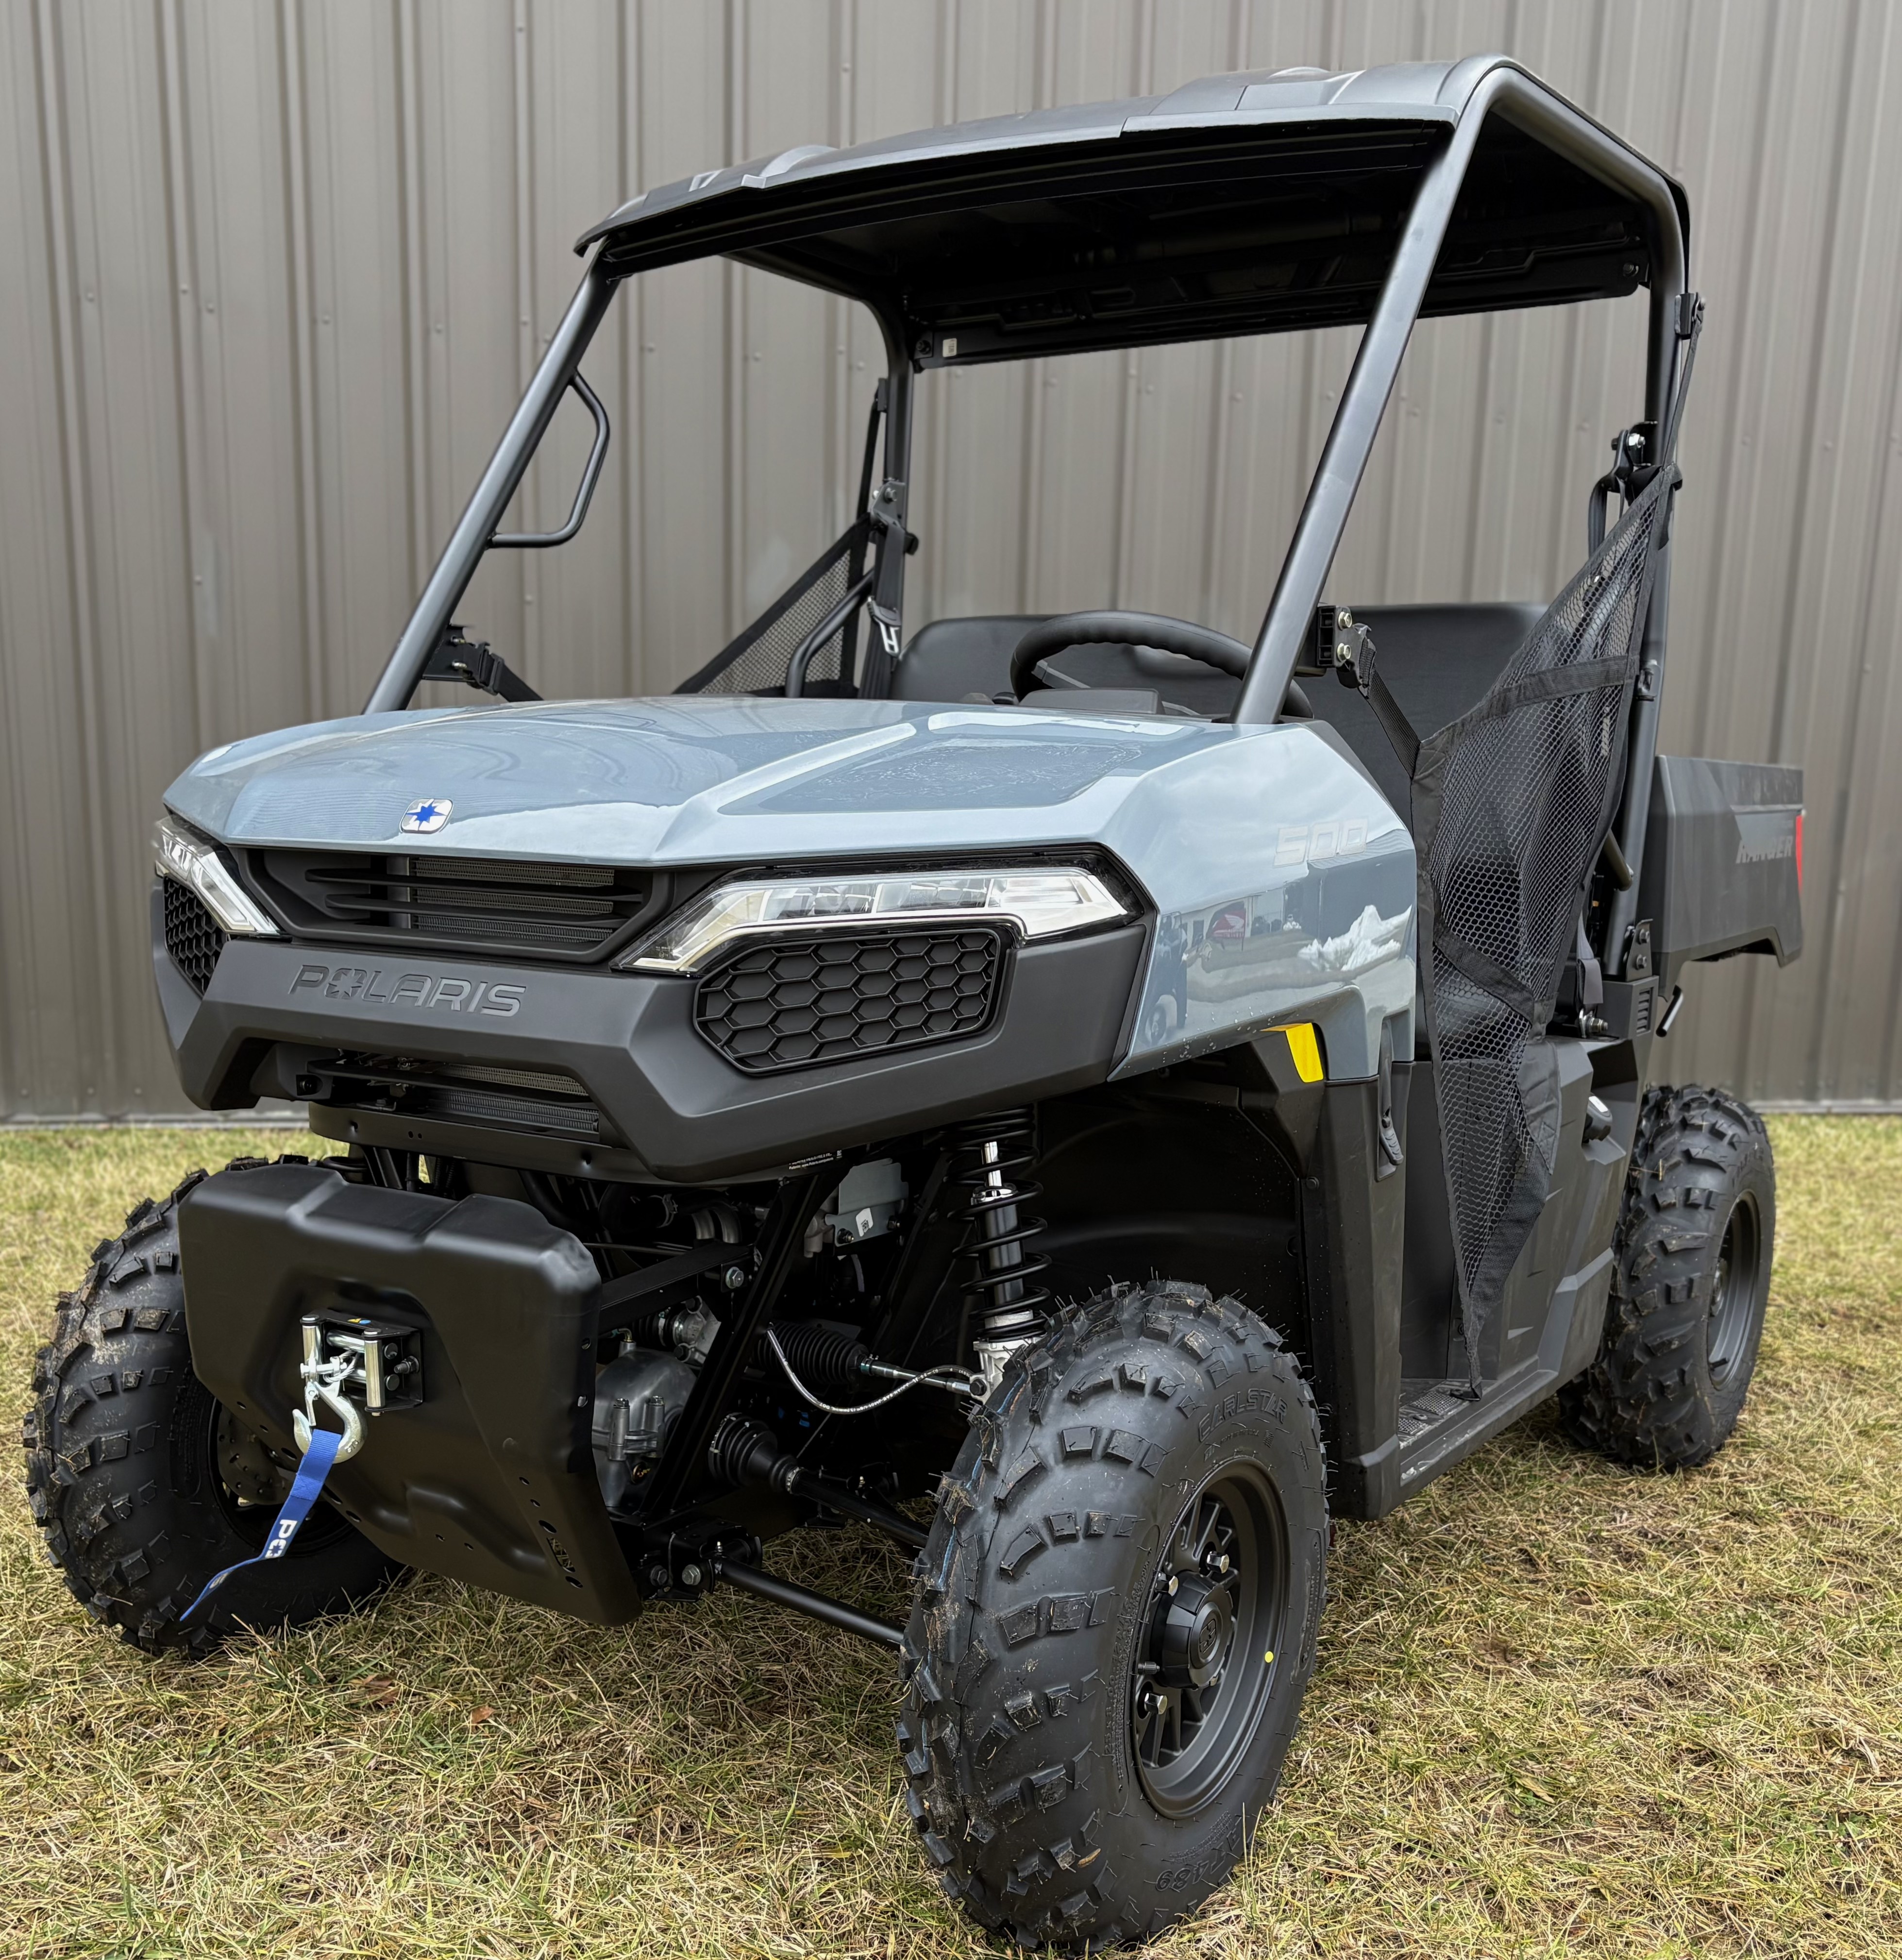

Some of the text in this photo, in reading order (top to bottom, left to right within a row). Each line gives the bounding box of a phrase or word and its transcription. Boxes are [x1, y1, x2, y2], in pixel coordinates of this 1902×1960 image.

[1274, 819, 1368, 868] 500
[288, 964, 526, 1017] POLARIS
[1198, 1388, 1287, 1442] CARLSTAR
